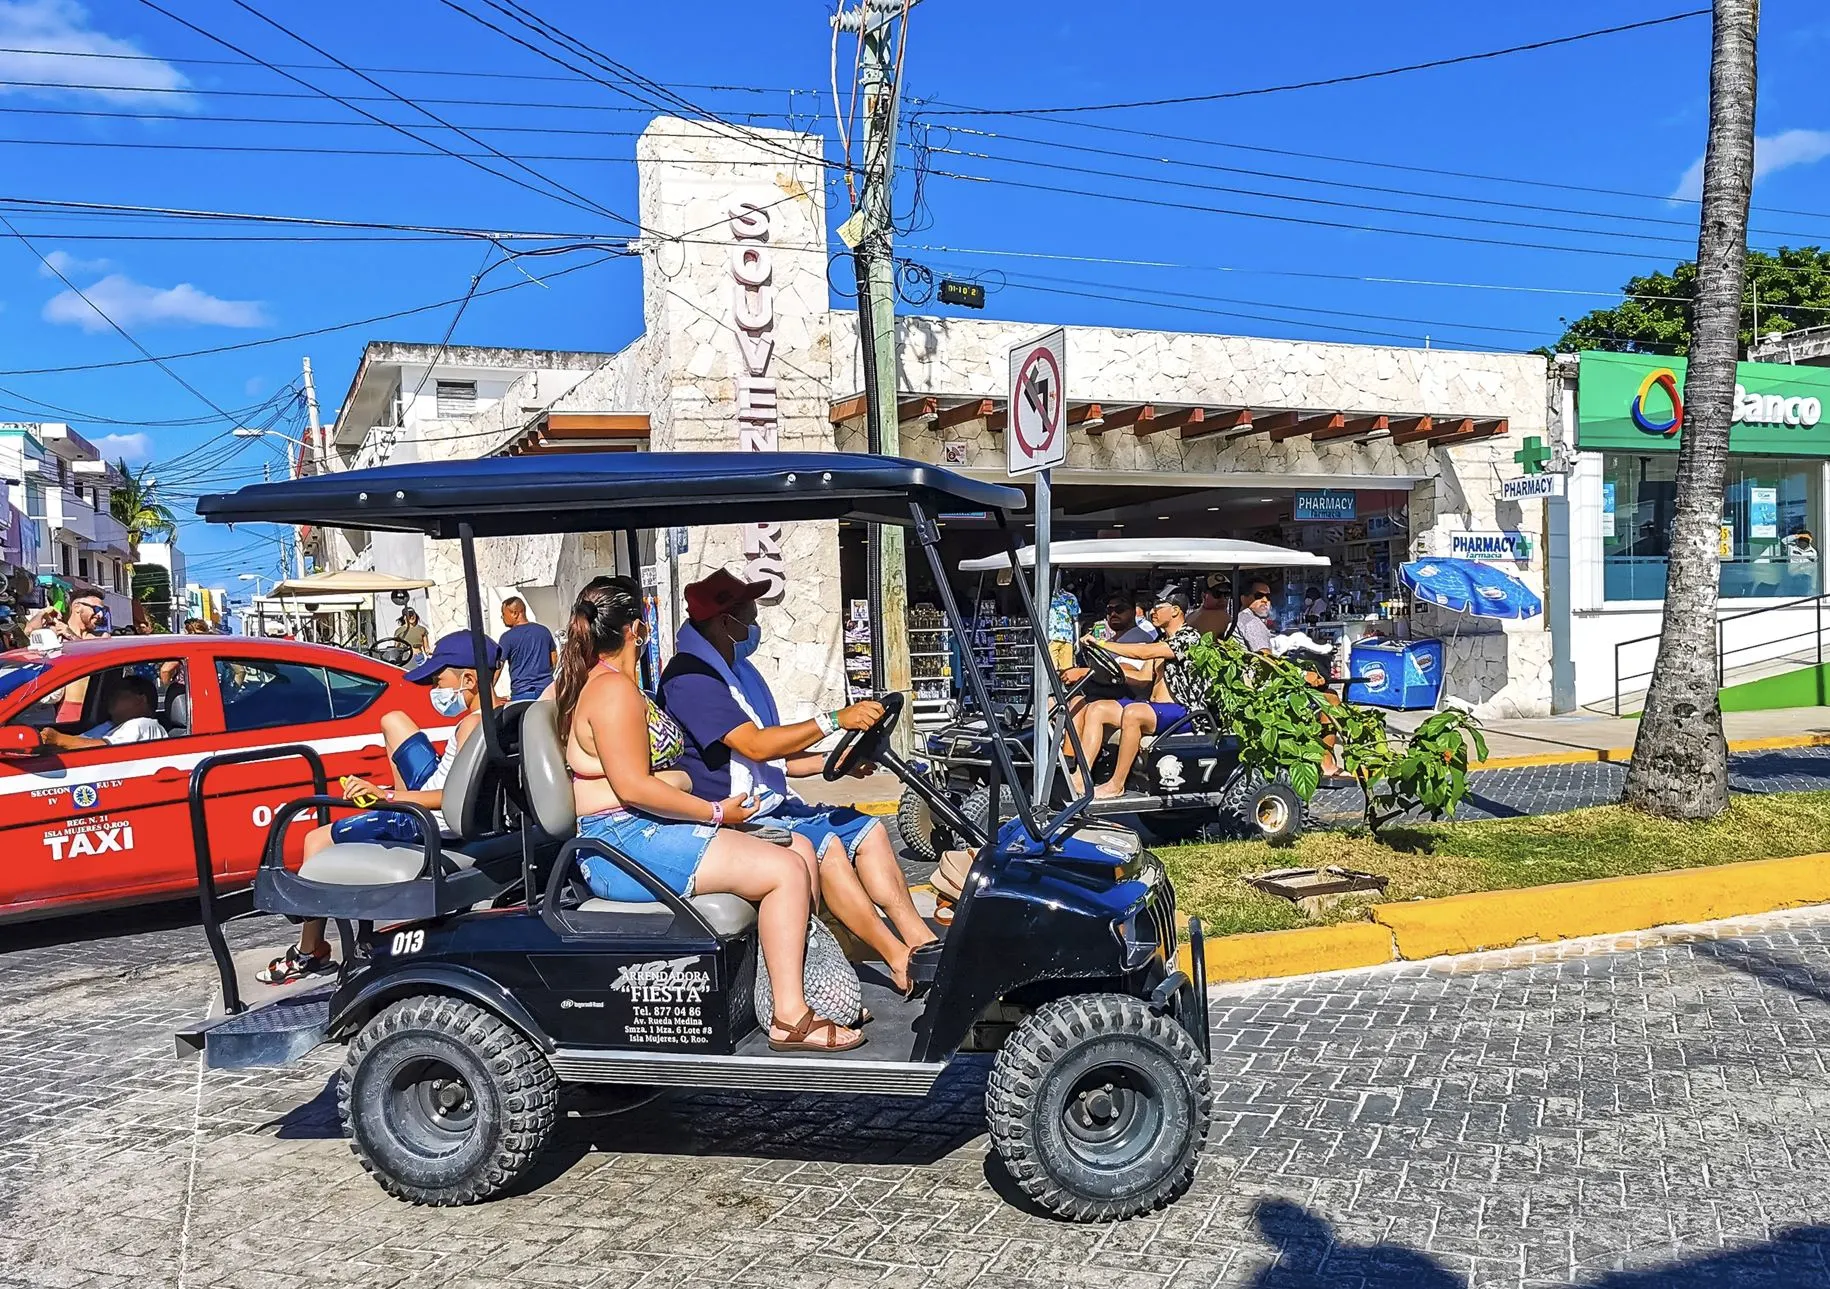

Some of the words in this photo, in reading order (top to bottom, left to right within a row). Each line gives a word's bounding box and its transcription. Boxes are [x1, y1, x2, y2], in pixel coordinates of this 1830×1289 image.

[728, 202, 785, 603] SOUVENRS
[1731, 384, 1821, 426] Banco
[1504, 478, 1553, 497] PHARMACY
[1299, 497, 1354, 510] PHARMACY
[1453, 537, 1516, 552] PHARMACY
[1198, 758, 1218, 783] 7
[31, 787, 70, 798] SECCION
[64, 824, 102, 836] MUJERES
[103, 820, 129, 831] Q.ROO
[66, 819, 87, 828] REG.
[43, 826, 134, 861] TAXI
[391, 930, 425, 957] 013
[622, 971, 710, 981] ARRENDADORA
[621, 985, 710, 1003] “FIESTA”
[632, 1006, 652, 1016] Tel.
[653, 1006, 672, 1016] 877
[674, 1006, 686, 1016] 04
[688, 1006, 701, 1016] 86
[633, 1017, 647, 1025] Av.
[648, 1017, 672, 1025] Rueda
[674, 1017, 703, 1026] Medina
[656, 1026, 674, 1034] Mza.
[683, 1027, 700, 1035] Lote
[702, 1027, 713, 1035] #8
[629, 1034, 644, 1042] Isla
[645, 1035, 679, 1044] Mujeres,
